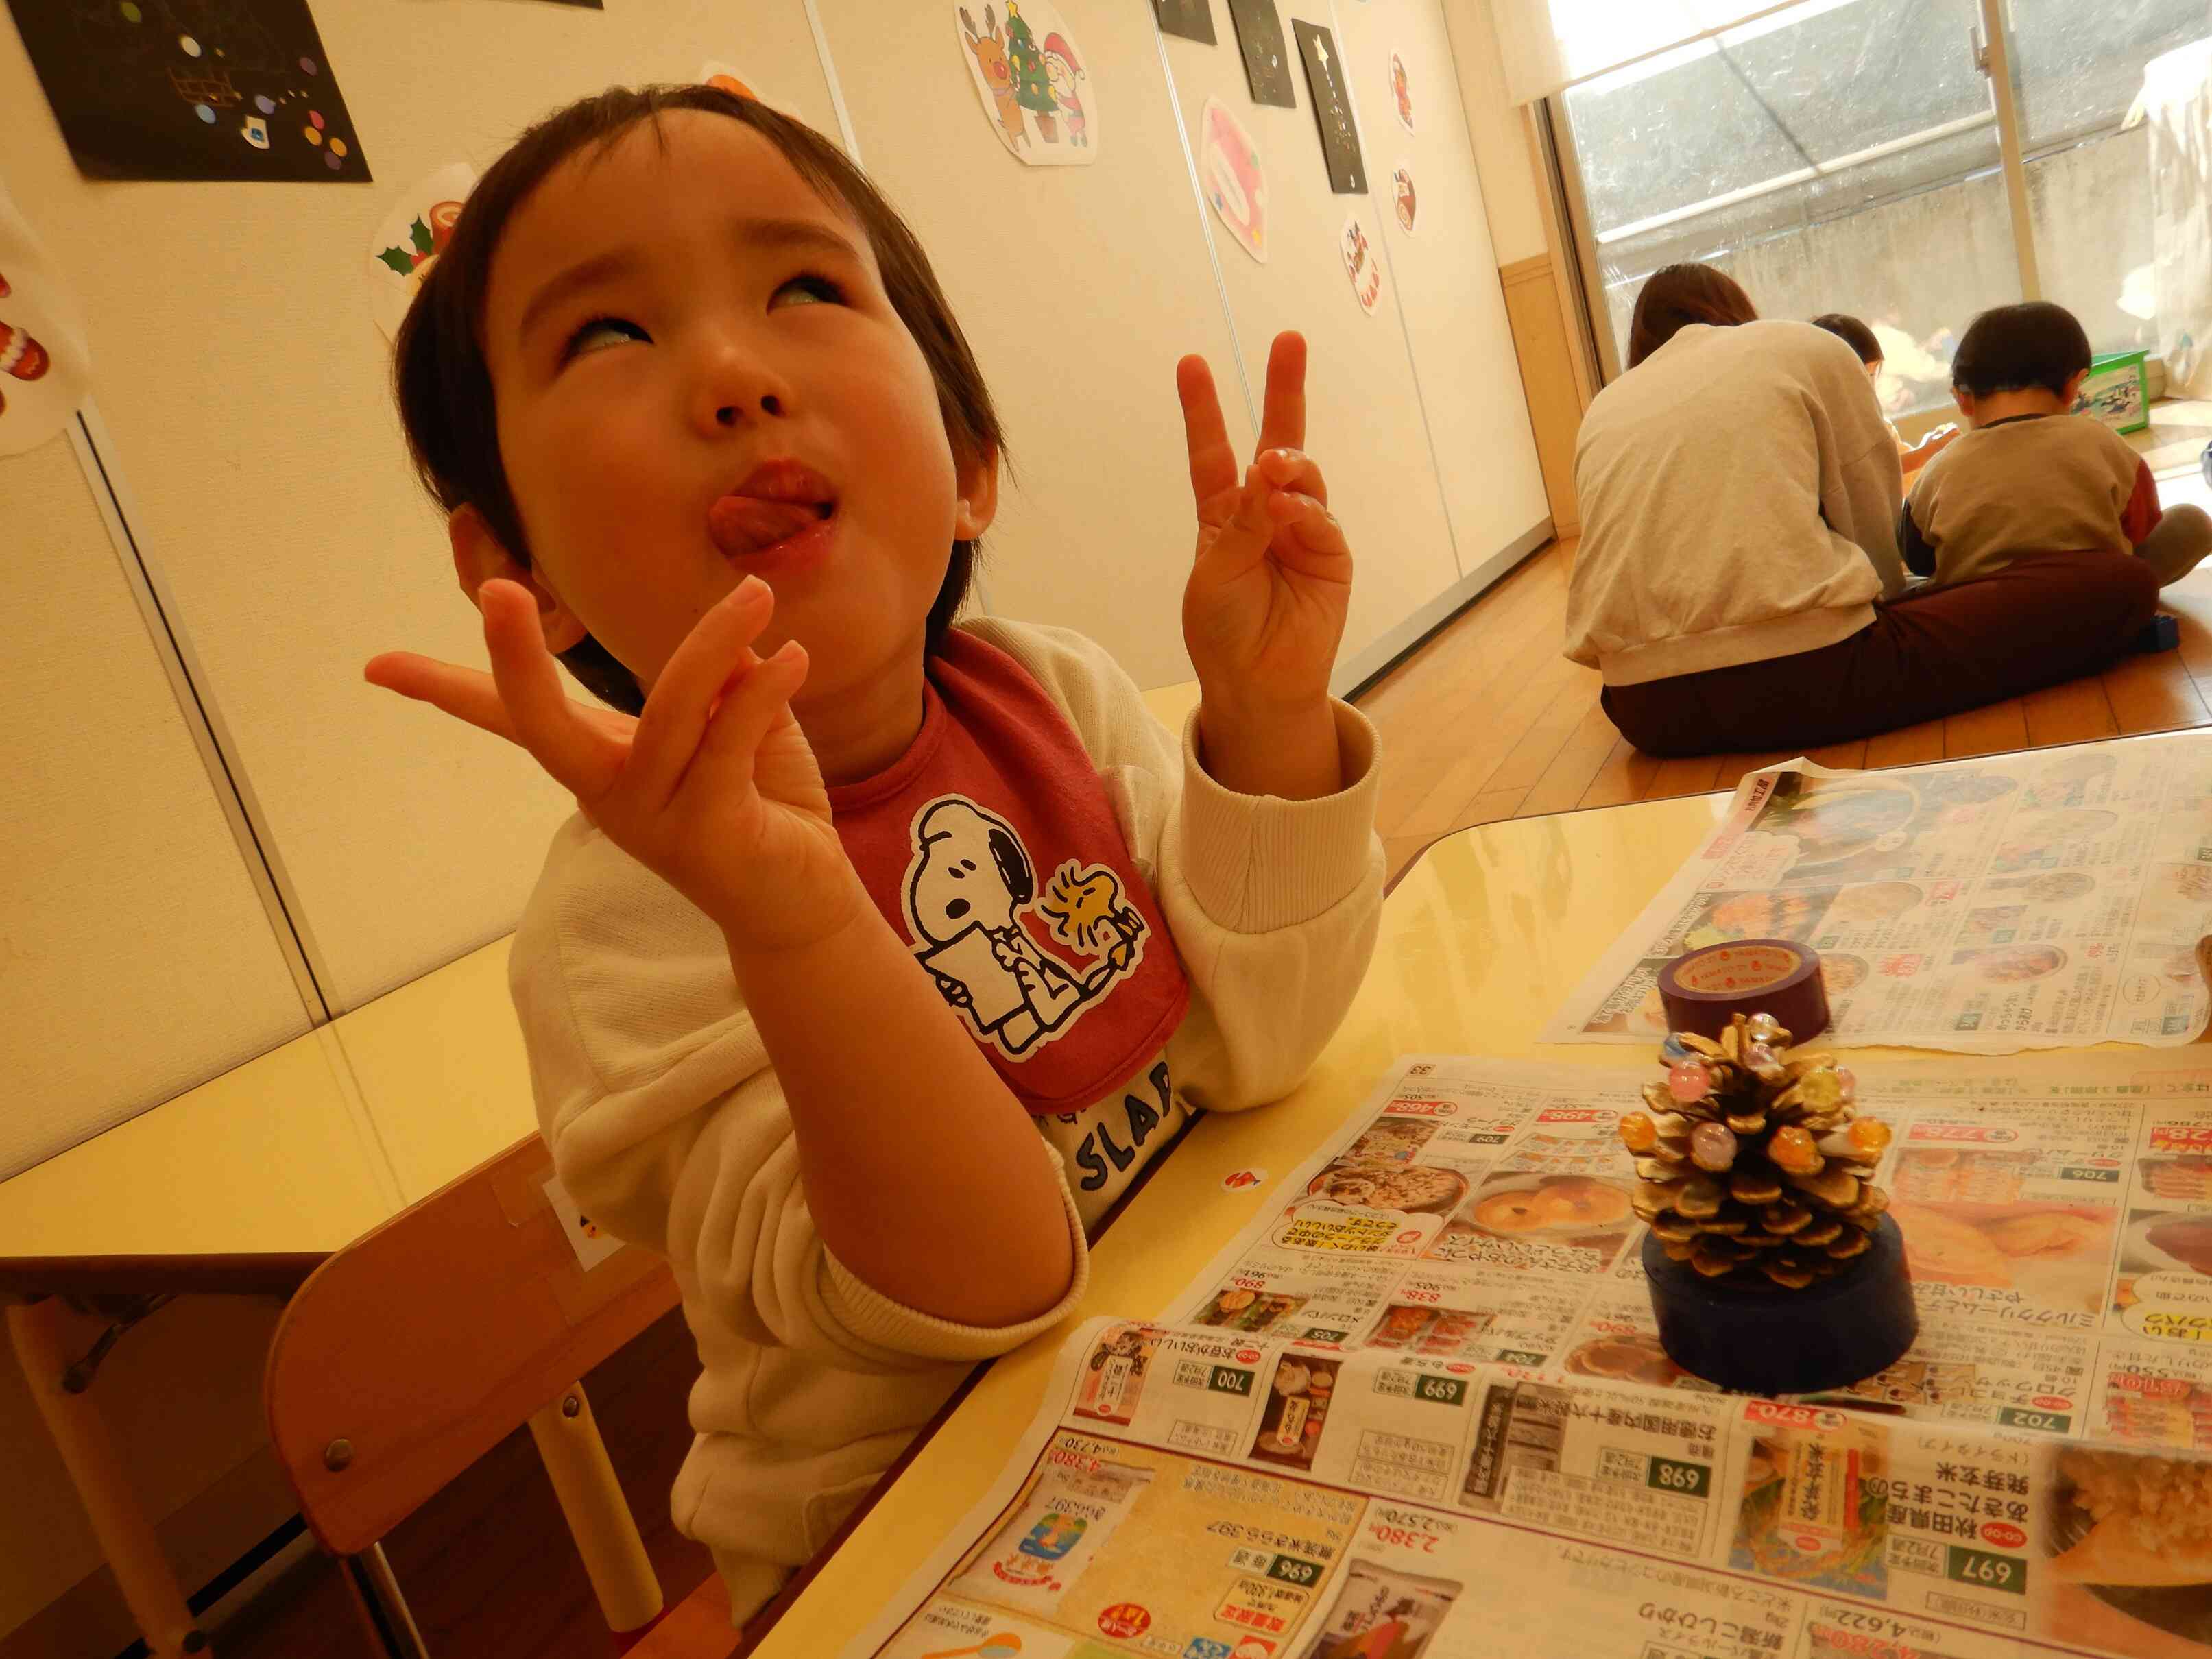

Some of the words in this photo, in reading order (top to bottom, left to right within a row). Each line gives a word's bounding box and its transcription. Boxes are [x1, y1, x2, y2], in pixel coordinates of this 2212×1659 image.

[1410, 1065, 1432, 1075] 33
[1476, 1134, 1500, 1143] 709
[2072, 1169, 2108, 1180] 706
[2144, 1313, 2212, 1329] クパク
[1313, 1329, 1339, 1342] 705
[1149, 1337, 1236, 1360] お豆がおいしい
[1217, 1372, 1243, 1391] 700
[1425, 1381, 1457, 1399] 699
[2012, 1412, 2057, 1430] 702
[1659, 1464, 1699, 1490] 698
[1935, 1462, 2030, 1497] 発芽玄米
[1867, 1476, 2030, 1524] あきたこまちの
[1885, 1502, 1978, 1541] 秋田県産
[1281, 1560, 1313, 1582] 696
[1962, 1556, 2012, 1584] 697
[1637, 1601, 1784, 1651] 新潟こしひかり
